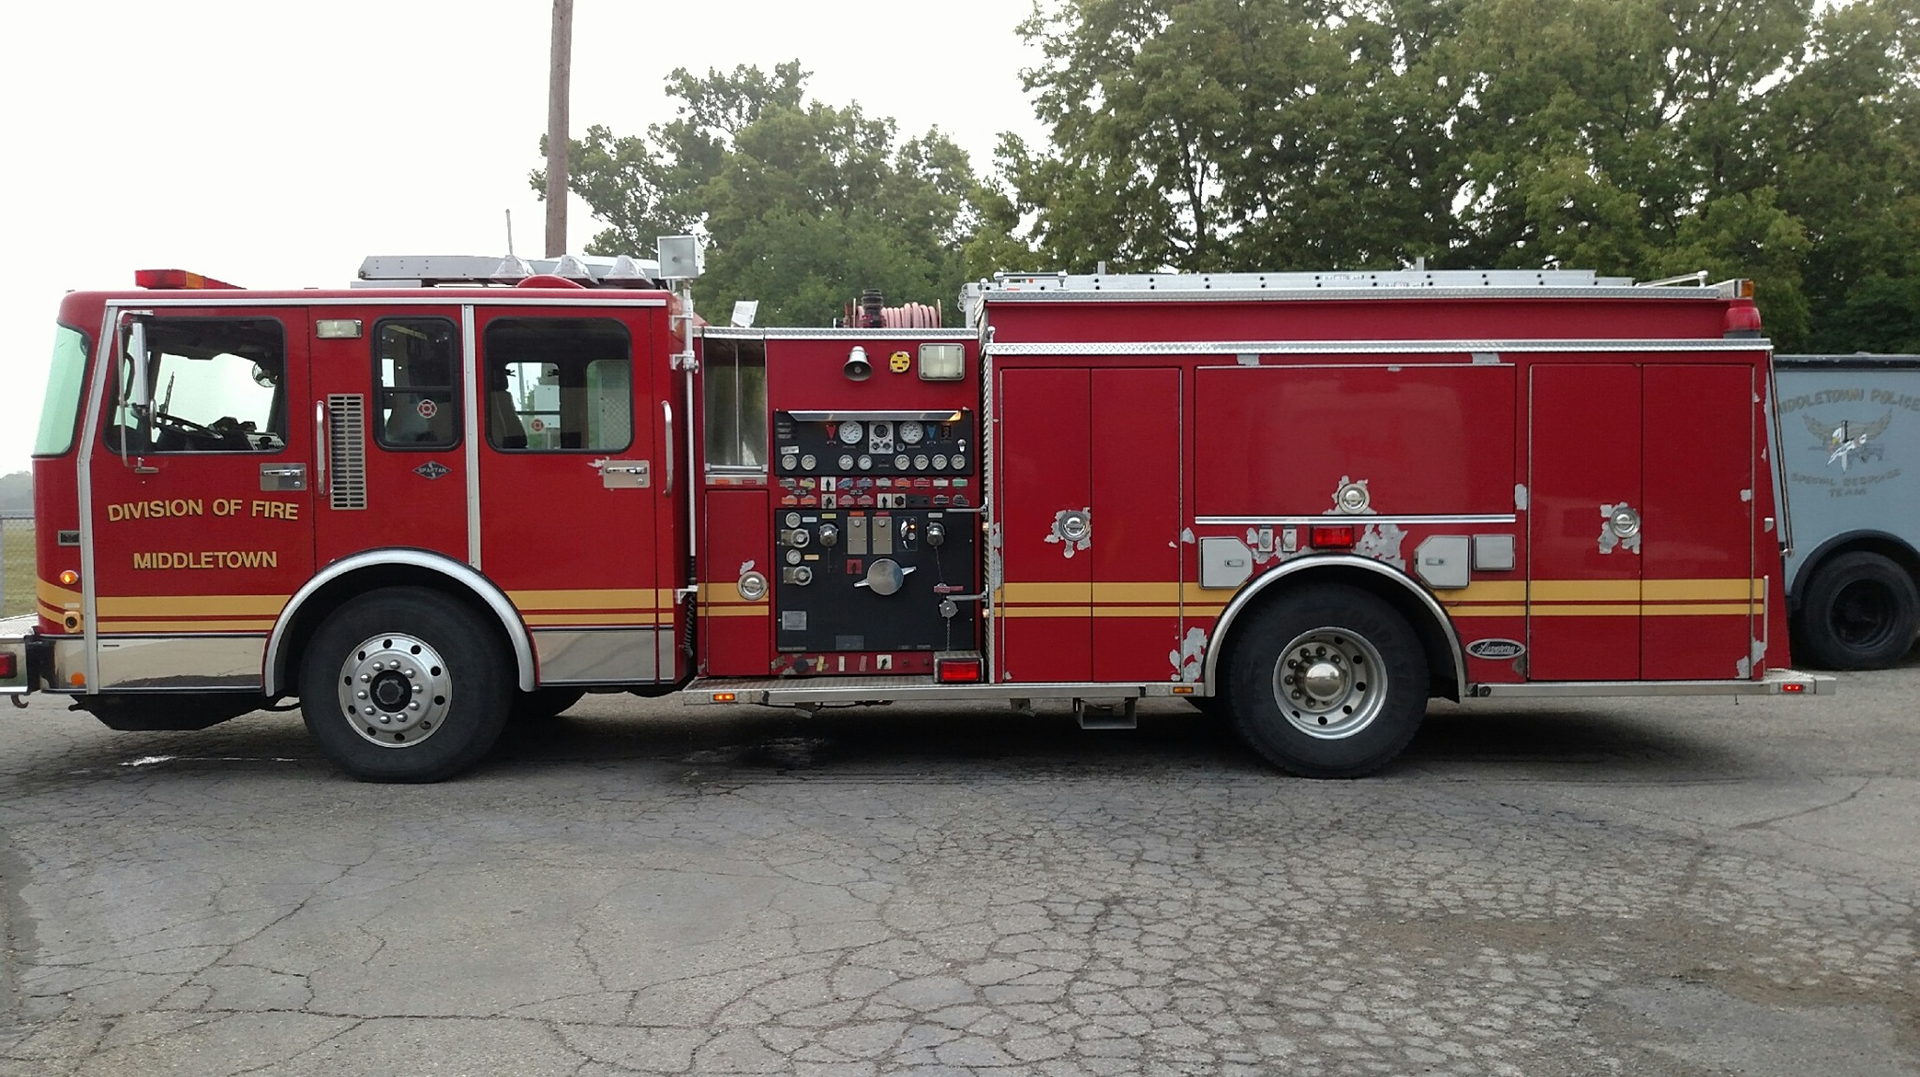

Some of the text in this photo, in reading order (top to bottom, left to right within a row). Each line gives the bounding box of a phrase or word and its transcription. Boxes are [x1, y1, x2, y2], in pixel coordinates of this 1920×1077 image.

[1870, 388, 1920, 412] POLICE
[1827, 487, 1867, 498] TEAM
[107, 498, 300, 522] DIVISION OF FIRE
[132, 551, 278, 570] MIDDLETOWN
